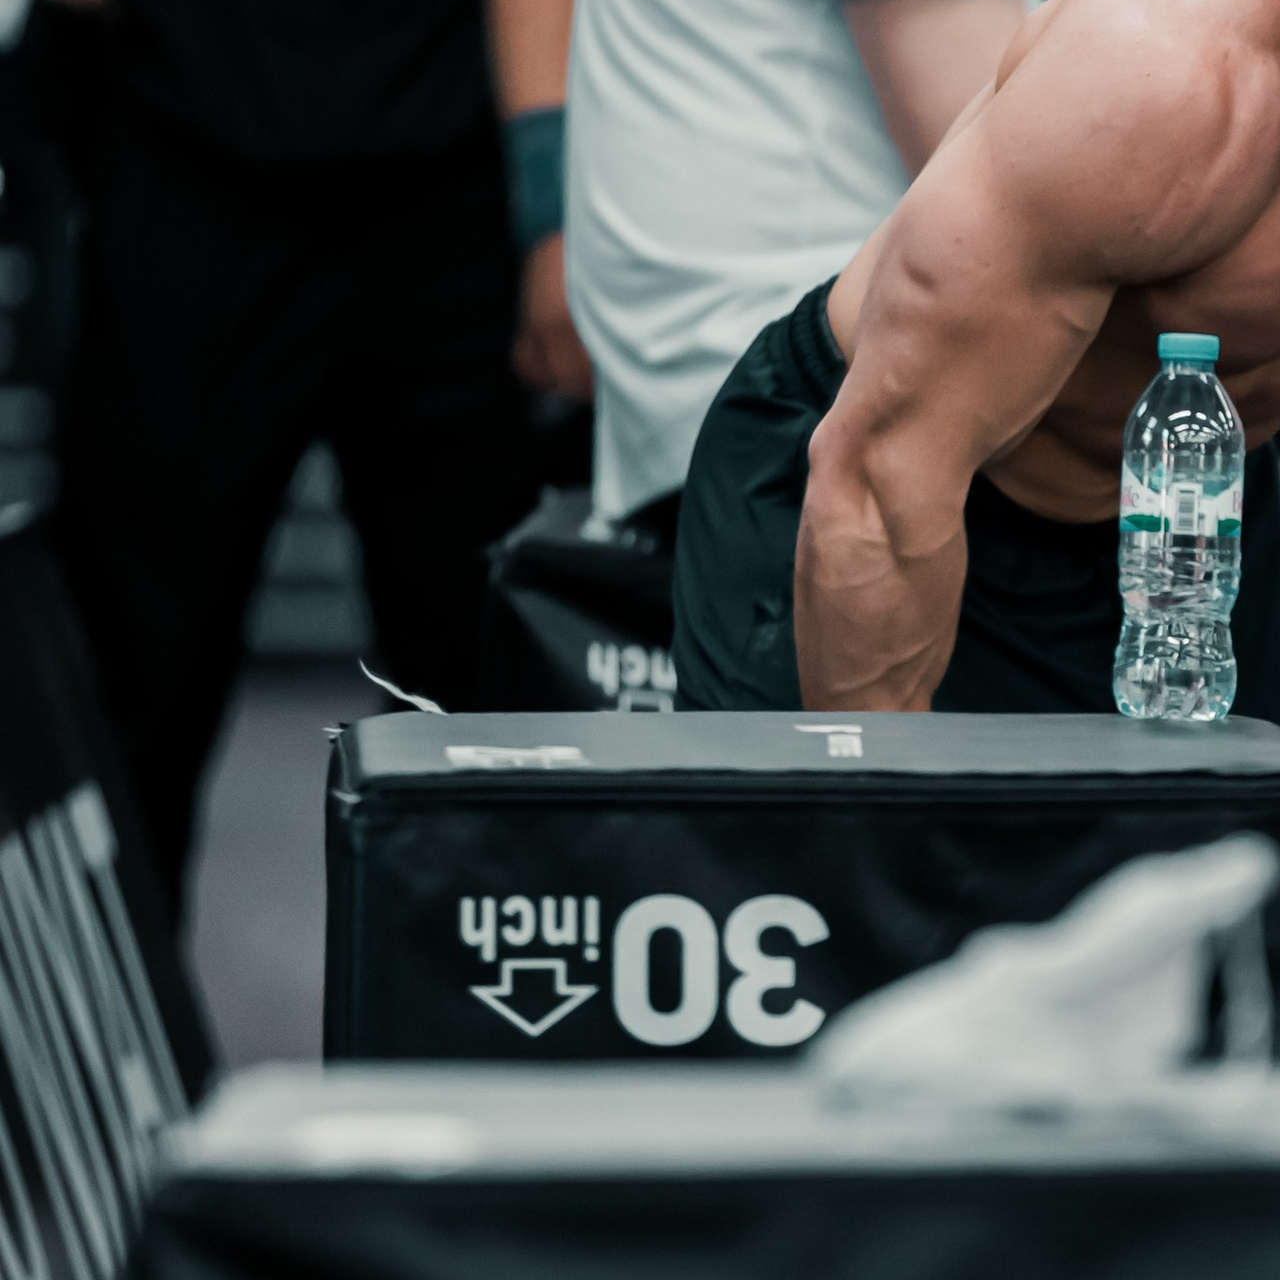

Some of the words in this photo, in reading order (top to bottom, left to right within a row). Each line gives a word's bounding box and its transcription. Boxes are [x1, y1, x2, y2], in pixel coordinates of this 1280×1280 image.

[585, 640, 678, 696] nch
[459, 894, 600, 963] inch
[612, 893, 831, 1047] 30
